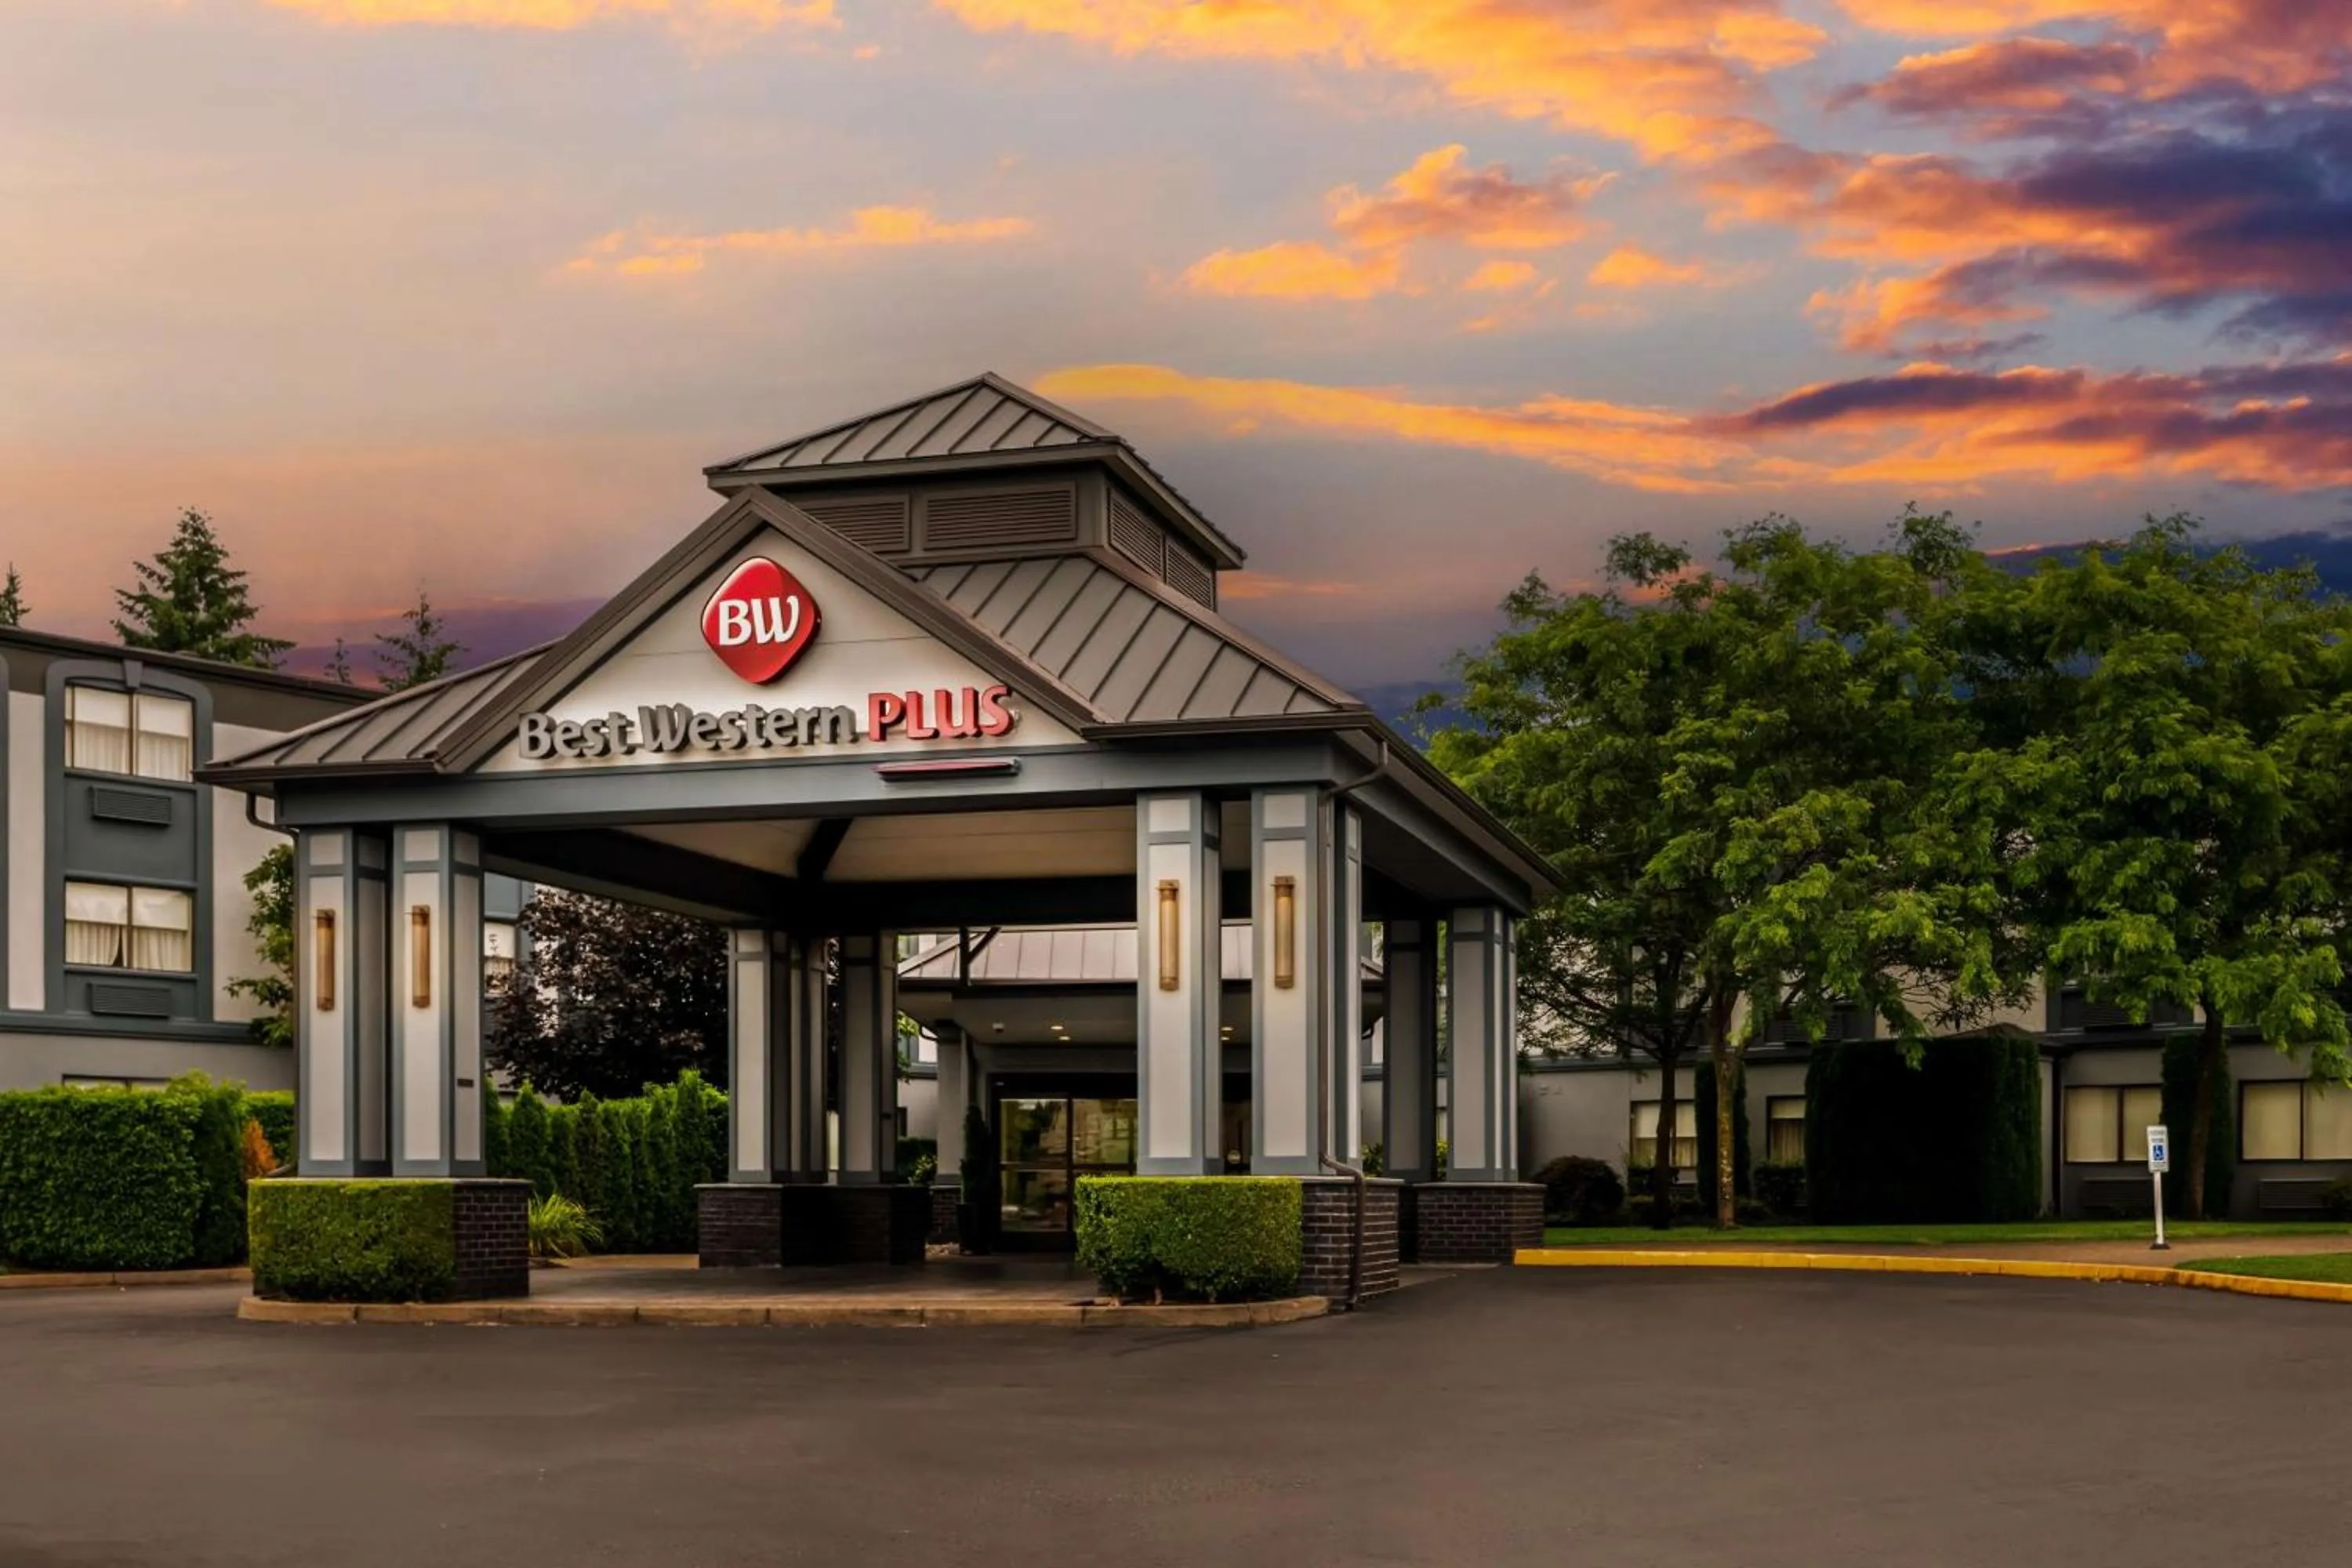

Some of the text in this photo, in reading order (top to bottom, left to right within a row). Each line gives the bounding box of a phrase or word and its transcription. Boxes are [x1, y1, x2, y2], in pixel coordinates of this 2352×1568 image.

[718, 595, 800, 646] BW
[519, 684, 1013, 759] Best Western PLUS
